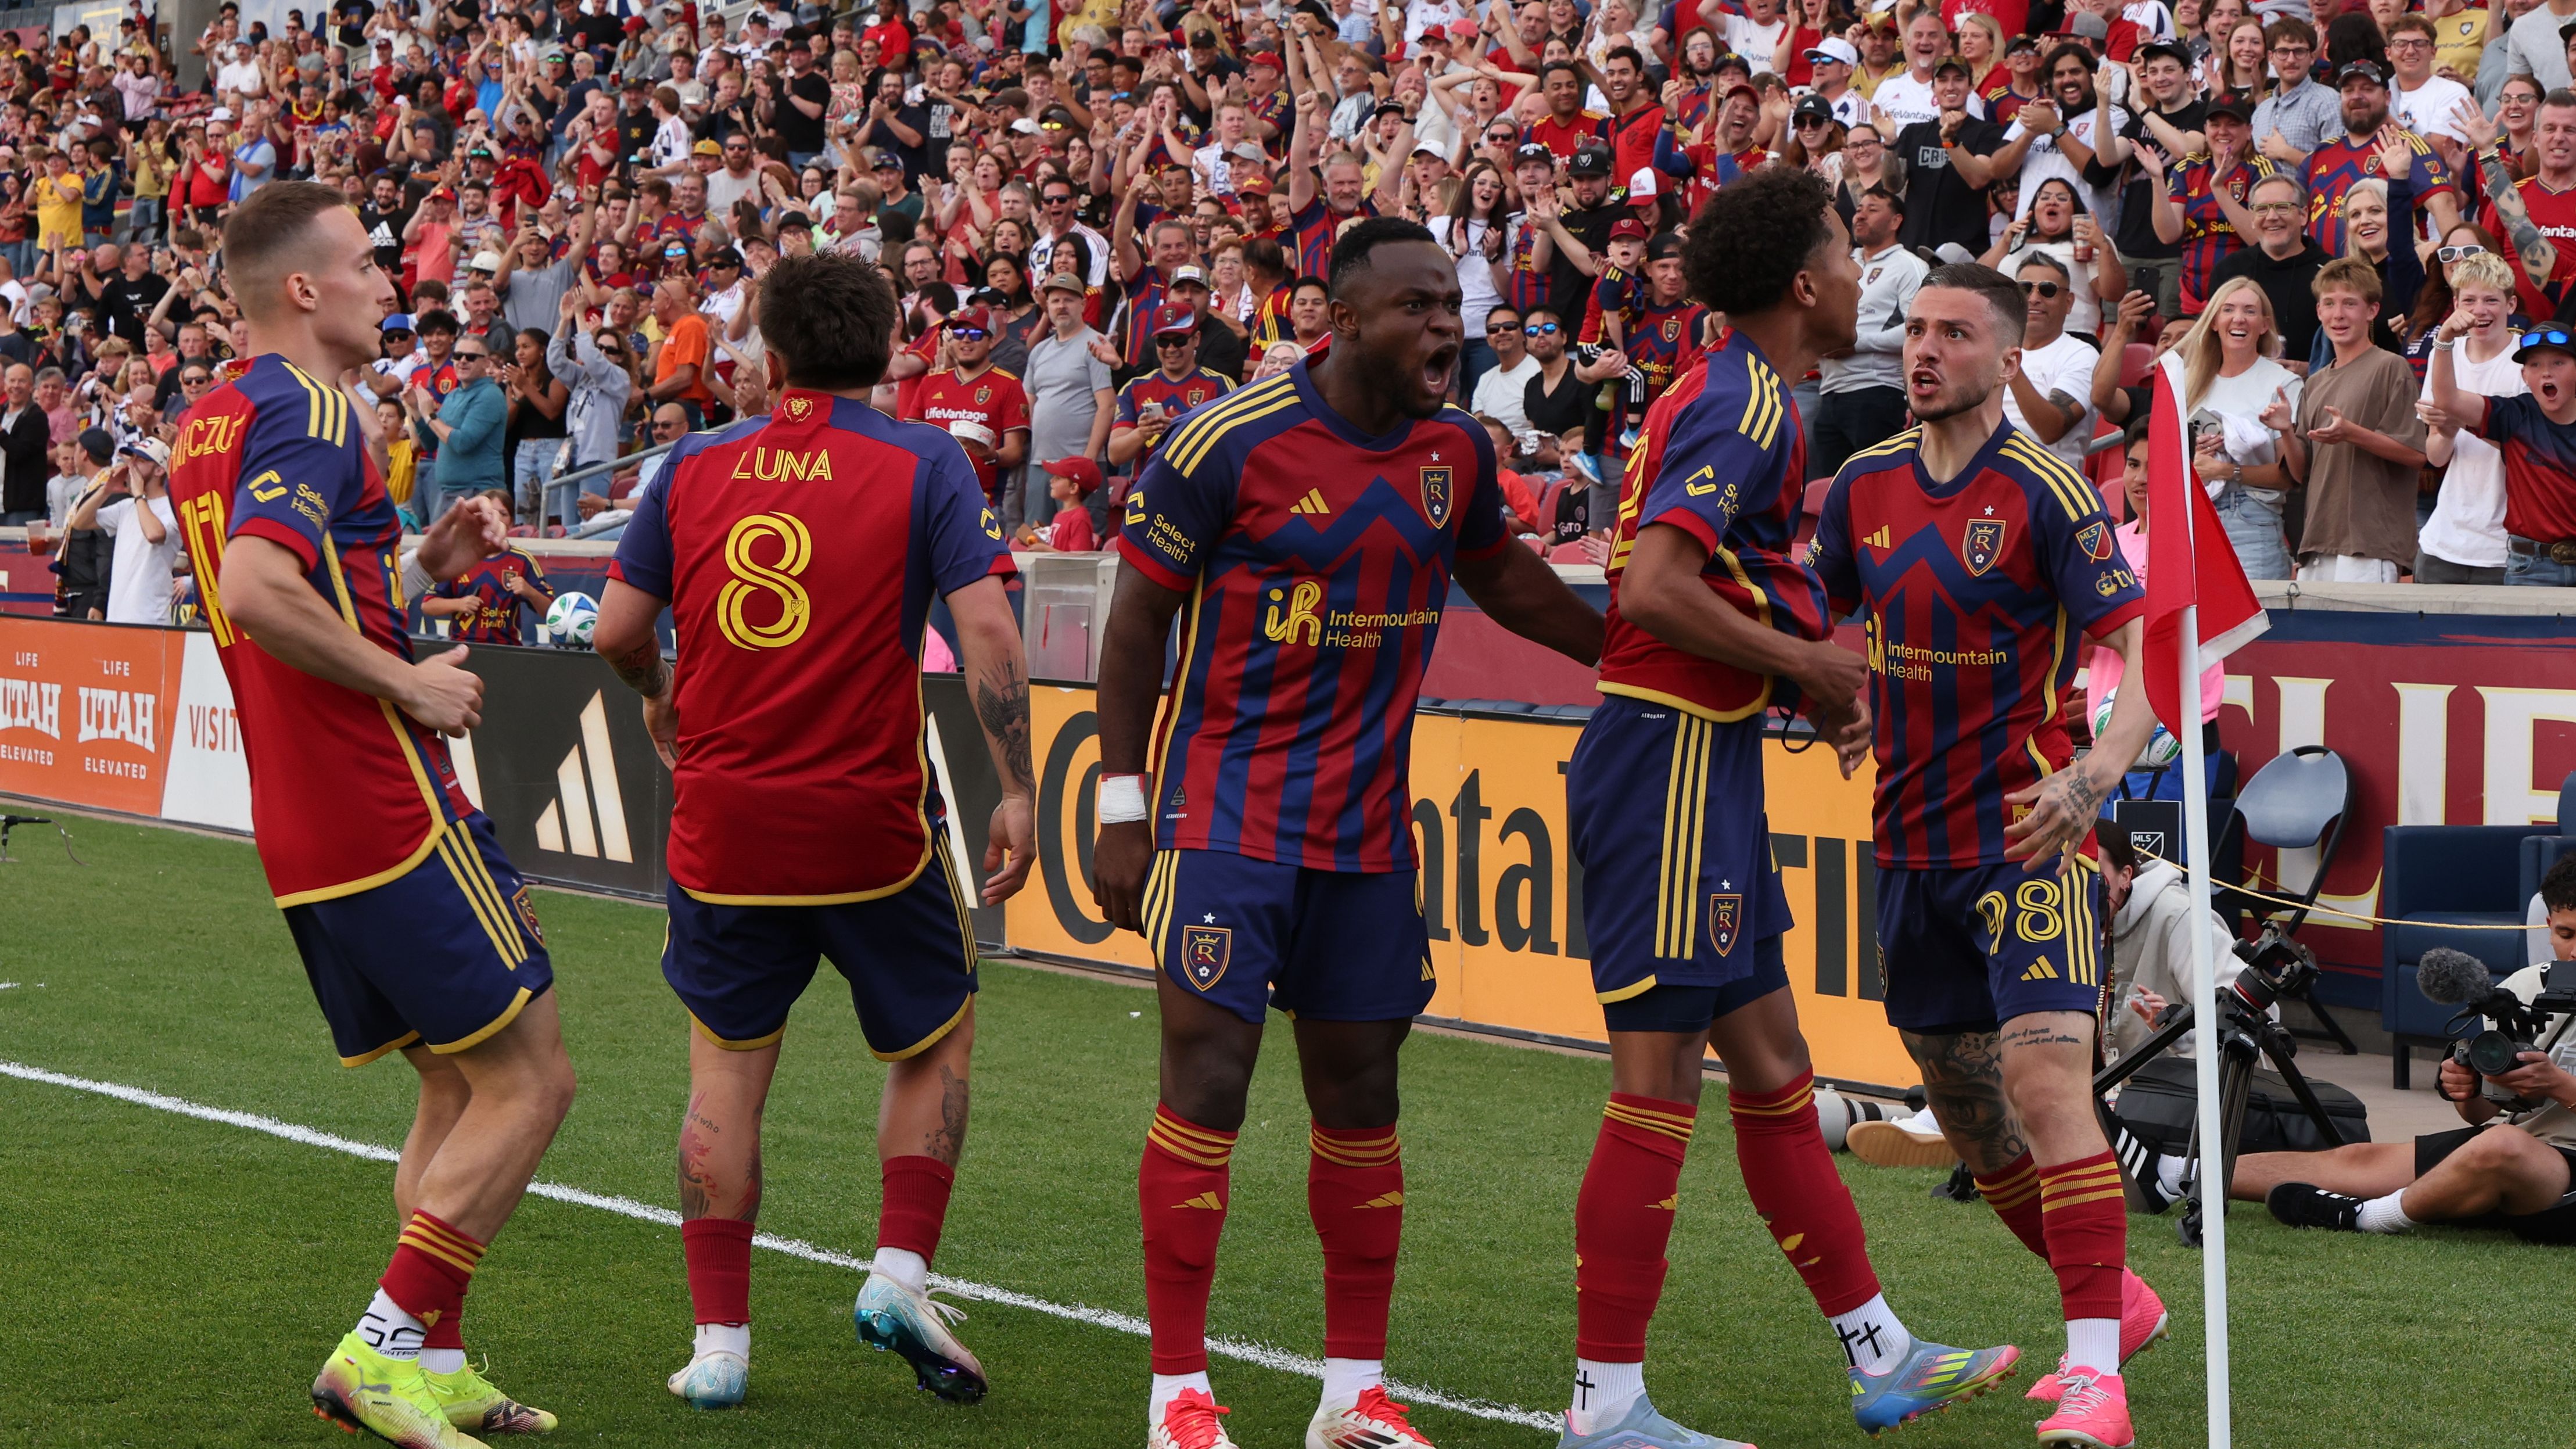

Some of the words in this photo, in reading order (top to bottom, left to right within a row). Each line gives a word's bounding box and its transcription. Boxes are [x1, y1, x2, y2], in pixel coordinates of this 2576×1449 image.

[1648, 374, 1669, 386] alth
[925, 408, 988, 422] LifeVantage
[731, 446, 833, 482] LUNA
[1146, 526, 1189, 564] Health
[1154, 514, 1196, 553] Select
[2080, 528, 2098, 542] MLS
[716, 511, 812, 651] 8
[1329, 607, 1439, 630] Intermountain
[1325, 630, 1382, 648] Health
[16, 652, 38, 667] LIFE
[1888, 640, 2008, 666] Intermountain
[103, 659, 131, 677] LIFE
[1888, 660, 1933, 683] Health
[0, 679, 62, 741] UTAH
[78, 687, 156, 753] UTAH
[189, 704, 238, 753] VISIT
[1, 744, 54, 766] ELEVATED
[84, 756, 147, 780] ELEVATED
[2133, 834, 2152, 843] MLS
[1976, 878, 2062, 956] 98
[2096, 985, 2106, 1012] anon
[699, 1117, 719, 1134] who
